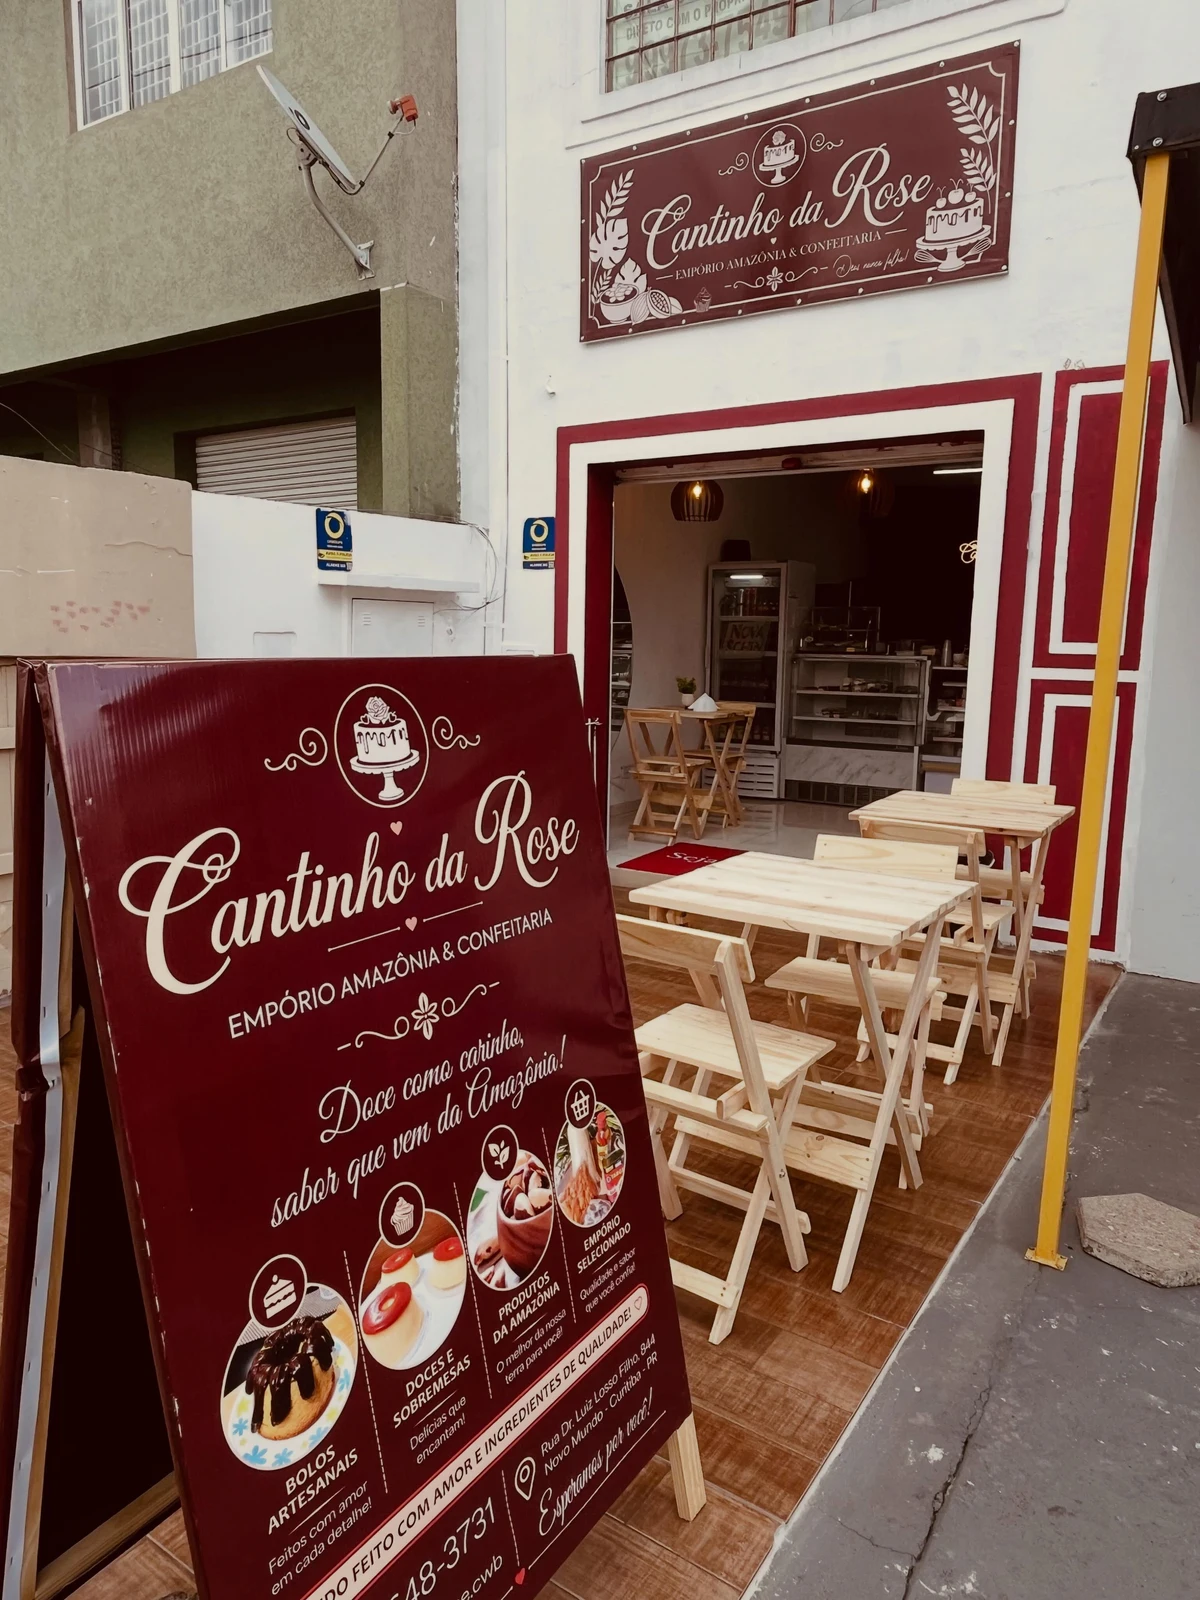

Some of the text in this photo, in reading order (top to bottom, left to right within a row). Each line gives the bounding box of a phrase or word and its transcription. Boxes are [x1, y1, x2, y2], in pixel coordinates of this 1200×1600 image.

[667, 10, 691, 28] CM
[641, 142, 934, 270] Cantinho da Rose
[675, 230, 882, 280] EMPÓRIO AMAZÔNIA & CONFEITARIA
[118, 770, 580, 996] Cantinho da Rose
[228, 908, 554, 1040] EMPÓRIO AMAZÔNIA & CONFEITARIA
[318, 1018, 525, 1144] Doce como carinho,
[270, 1033, 567, 1228] sabor que vem da Amazônia!
[577, 1222, 631, 1274] SELECIONADO
[583, 1214, 621, 1252] EMPÓRIO
[498, 1271, 551, 1322] PRODUTOS
[579, 1247, 636, 1301] Qualidade e sabor
[585, 1261, 636, 1313] que você confia!
[493, 1281, 561, 1345] DA AMAZÔNIA
[496, 1308, 567, 1374] O melhor da nossa
[405, 1348, 455, 1398] DOCES E
[505, 1325, 564, 1385] terra para você!
[392, 1354, 472, 1429] SOBREMESAS
[409, 1395, 468, 1451] Delícias que
[540, 1435, 559, 1457] Rua
[560, 1417, 576, 1439] Dr.
[575, 1399, 594, 1428] Luiz
[594, 1378, 618, 1404] Losso
[640, 1333, 656, 1356] 844
[544, 1444, 571, 1476] Novo
[571, 1410, 604, 1449] Mundo
[609, 1369, 642, 1407] Curitiba
[646, 1351, 658, 1370] PR
[285, 1444, 336, 1496] BOLOS
[320, 1306, 633, 1600] DO FEITO COM AMOR E INGREDIENTES DE QUALIDADE!
[416, 1413, 467, 1465] encantam!
[538, 1386, 654, 1537] Esperamos por você!
[268, 1448, 359, 1535] ARTESANAIS
[268, 1480, 369, 1576] Feitos com amor
[271, 1496, 373, 1597] em cada detalhe!
[390, 1496, 496, 1600] 48-3731
[457, 1555, 503, 1600] e.cwb
